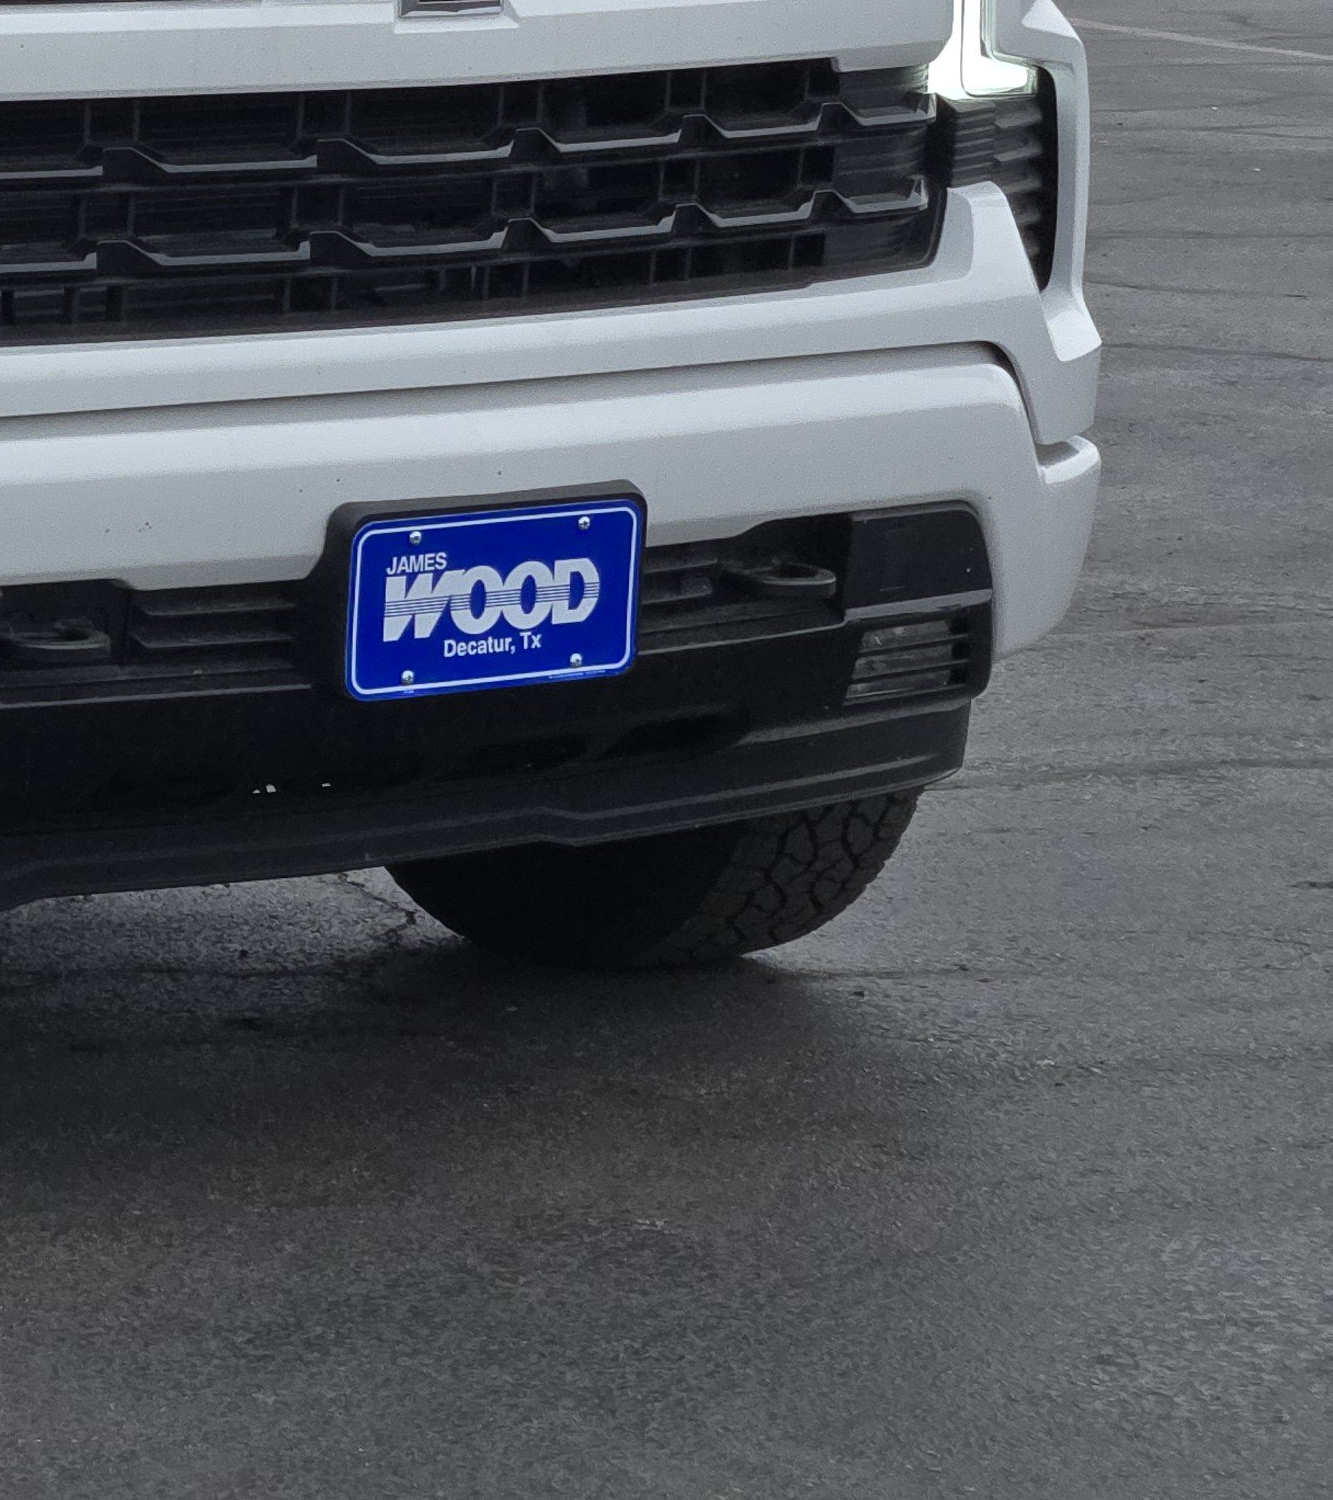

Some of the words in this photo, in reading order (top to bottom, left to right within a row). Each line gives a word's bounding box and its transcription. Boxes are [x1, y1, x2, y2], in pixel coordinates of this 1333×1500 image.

[386, 552, 447, 575] JAMES
[382, 557, 601, 642] WOOD
[444, 635, 515, 658] Decatur,
[520, 631, 542, 650] Tx
